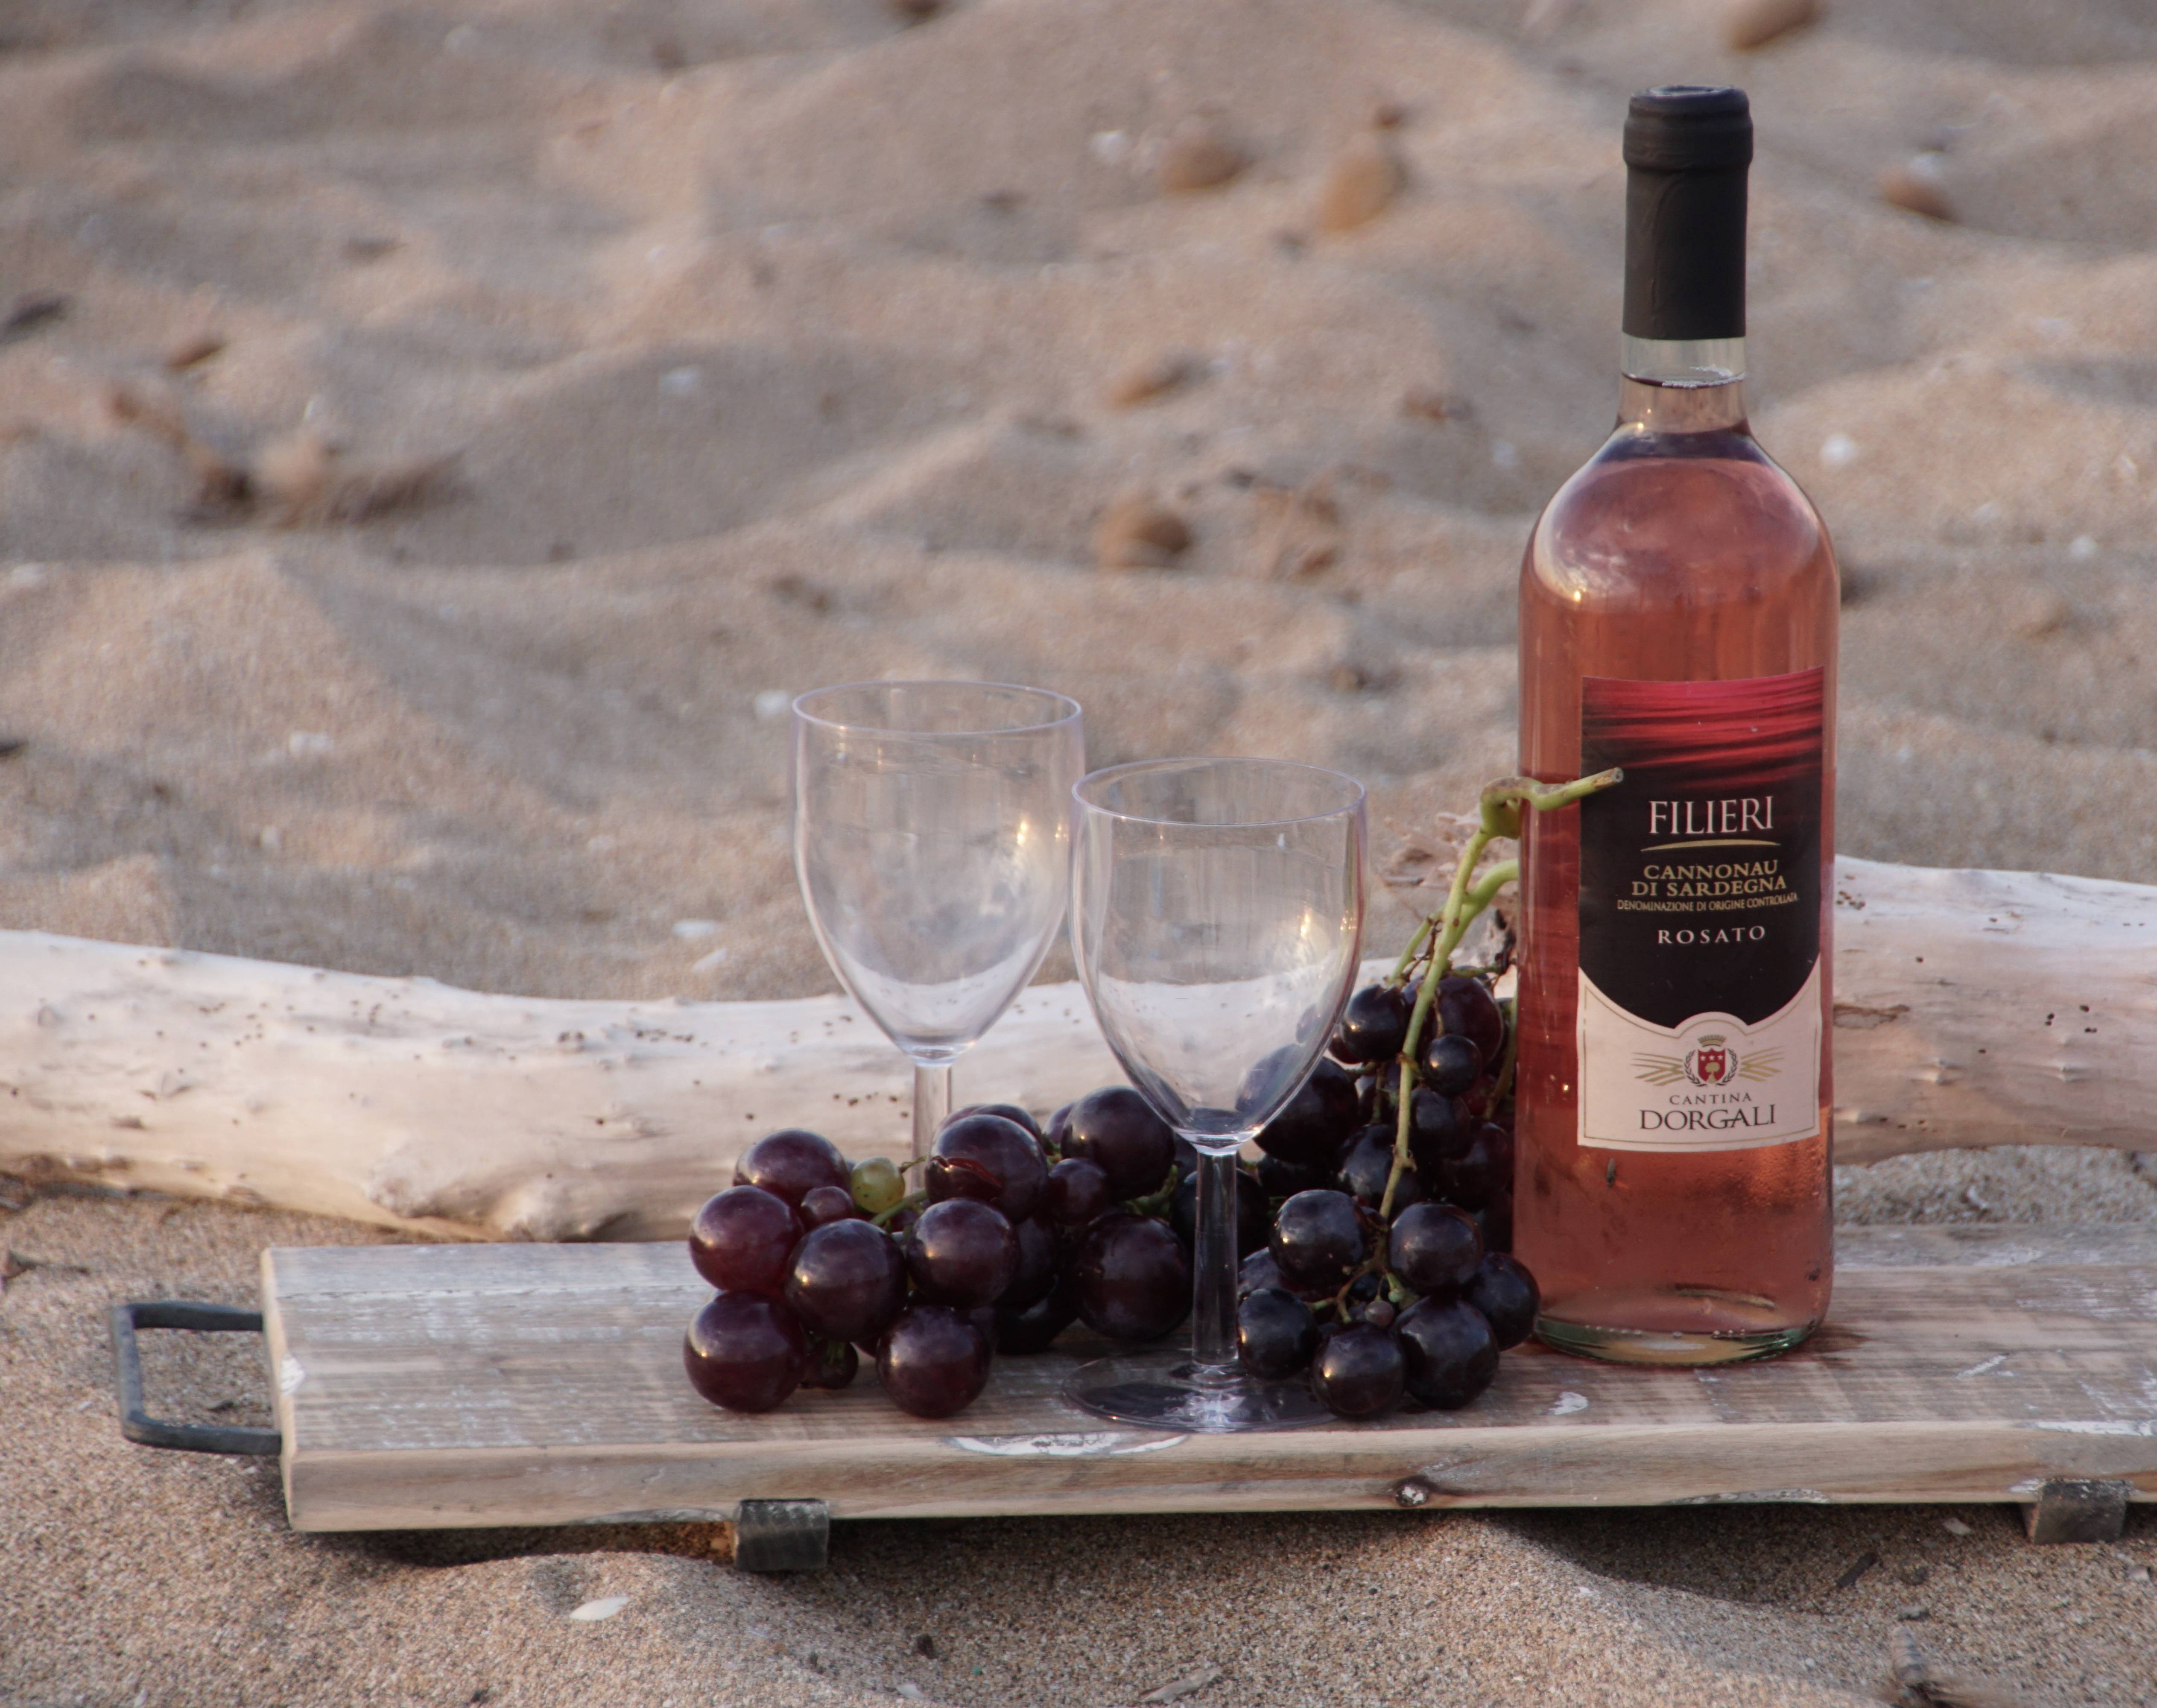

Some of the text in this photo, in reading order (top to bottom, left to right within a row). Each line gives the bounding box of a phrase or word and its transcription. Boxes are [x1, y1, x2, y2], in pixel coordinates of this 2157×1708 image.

[1649, 796, 1773, 834] FILIERI
[1644, 860, 1778, 880] CANNONAU
[1632, 876, 1786, 897] DI SARDEGNA
[1617, 892, 1798, 912] DENOMINAZIONE DI ORIGINE CONTROLLATA
[1657, 925, 1765, 944] ROSATO
[1669, 1092, 1752, 1105] CANTINA
[1639, 1104, 1776, 1130] DORGALI
